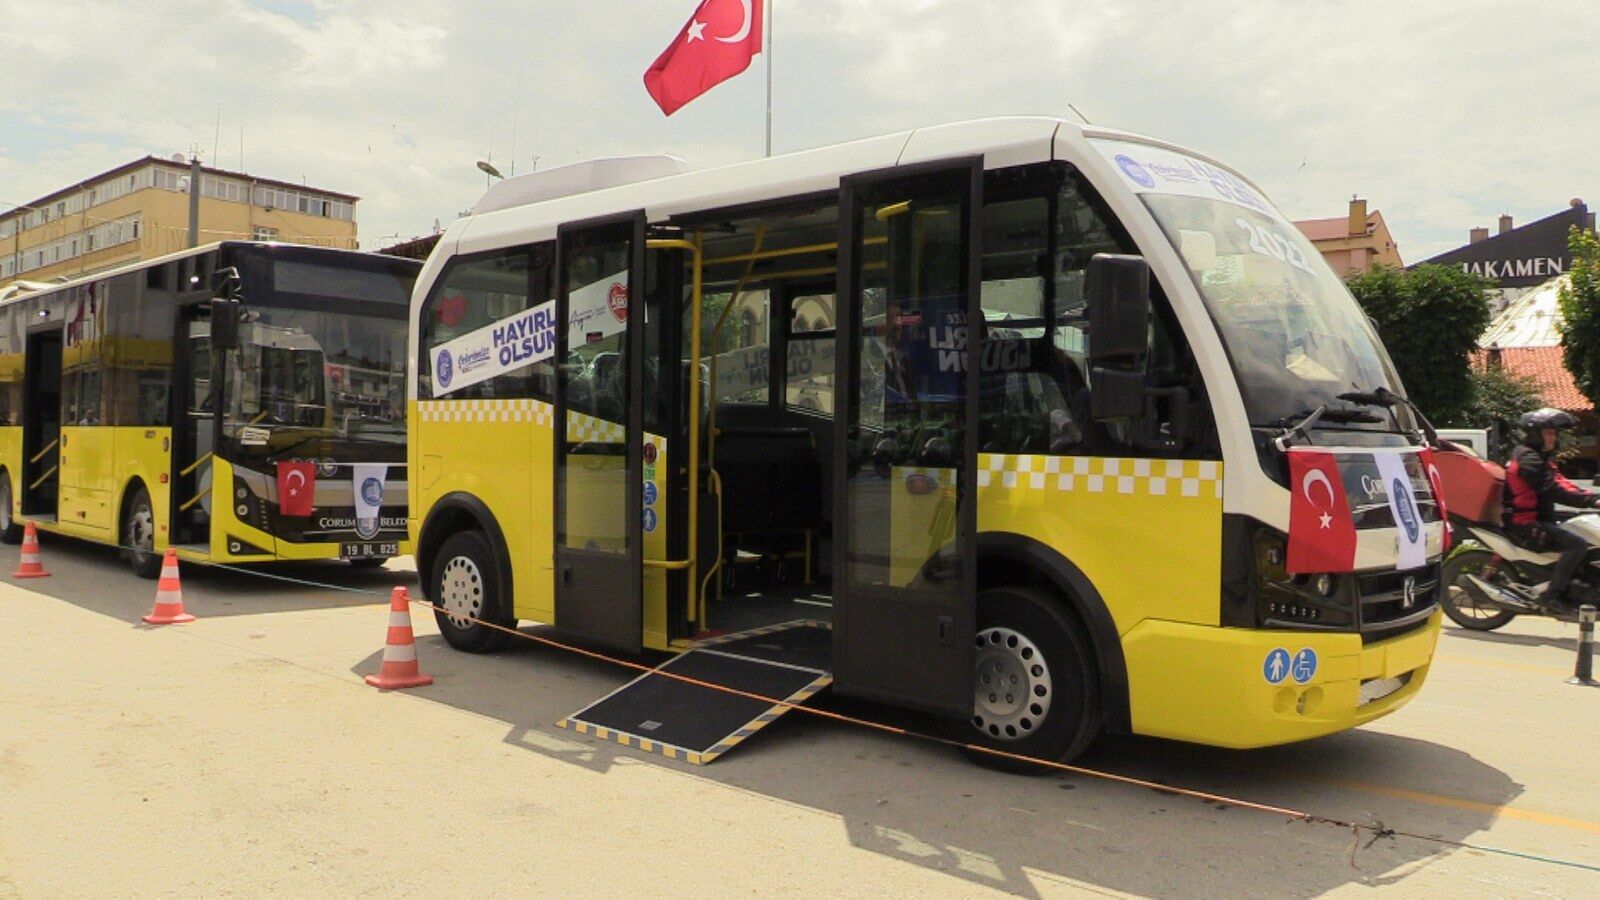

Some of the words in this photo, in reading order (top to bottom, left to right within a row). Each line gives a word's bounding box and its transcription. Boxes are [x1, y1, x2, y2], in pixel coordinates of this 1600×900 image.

[1236, 218, 1319, 277] 2022
[493, 308, 556, 349] HAYIRL
[319, 517, 356, 529] ÇORUM
[380, 517, 408, 528] BELED
[346, 544, 358, 556] 19
